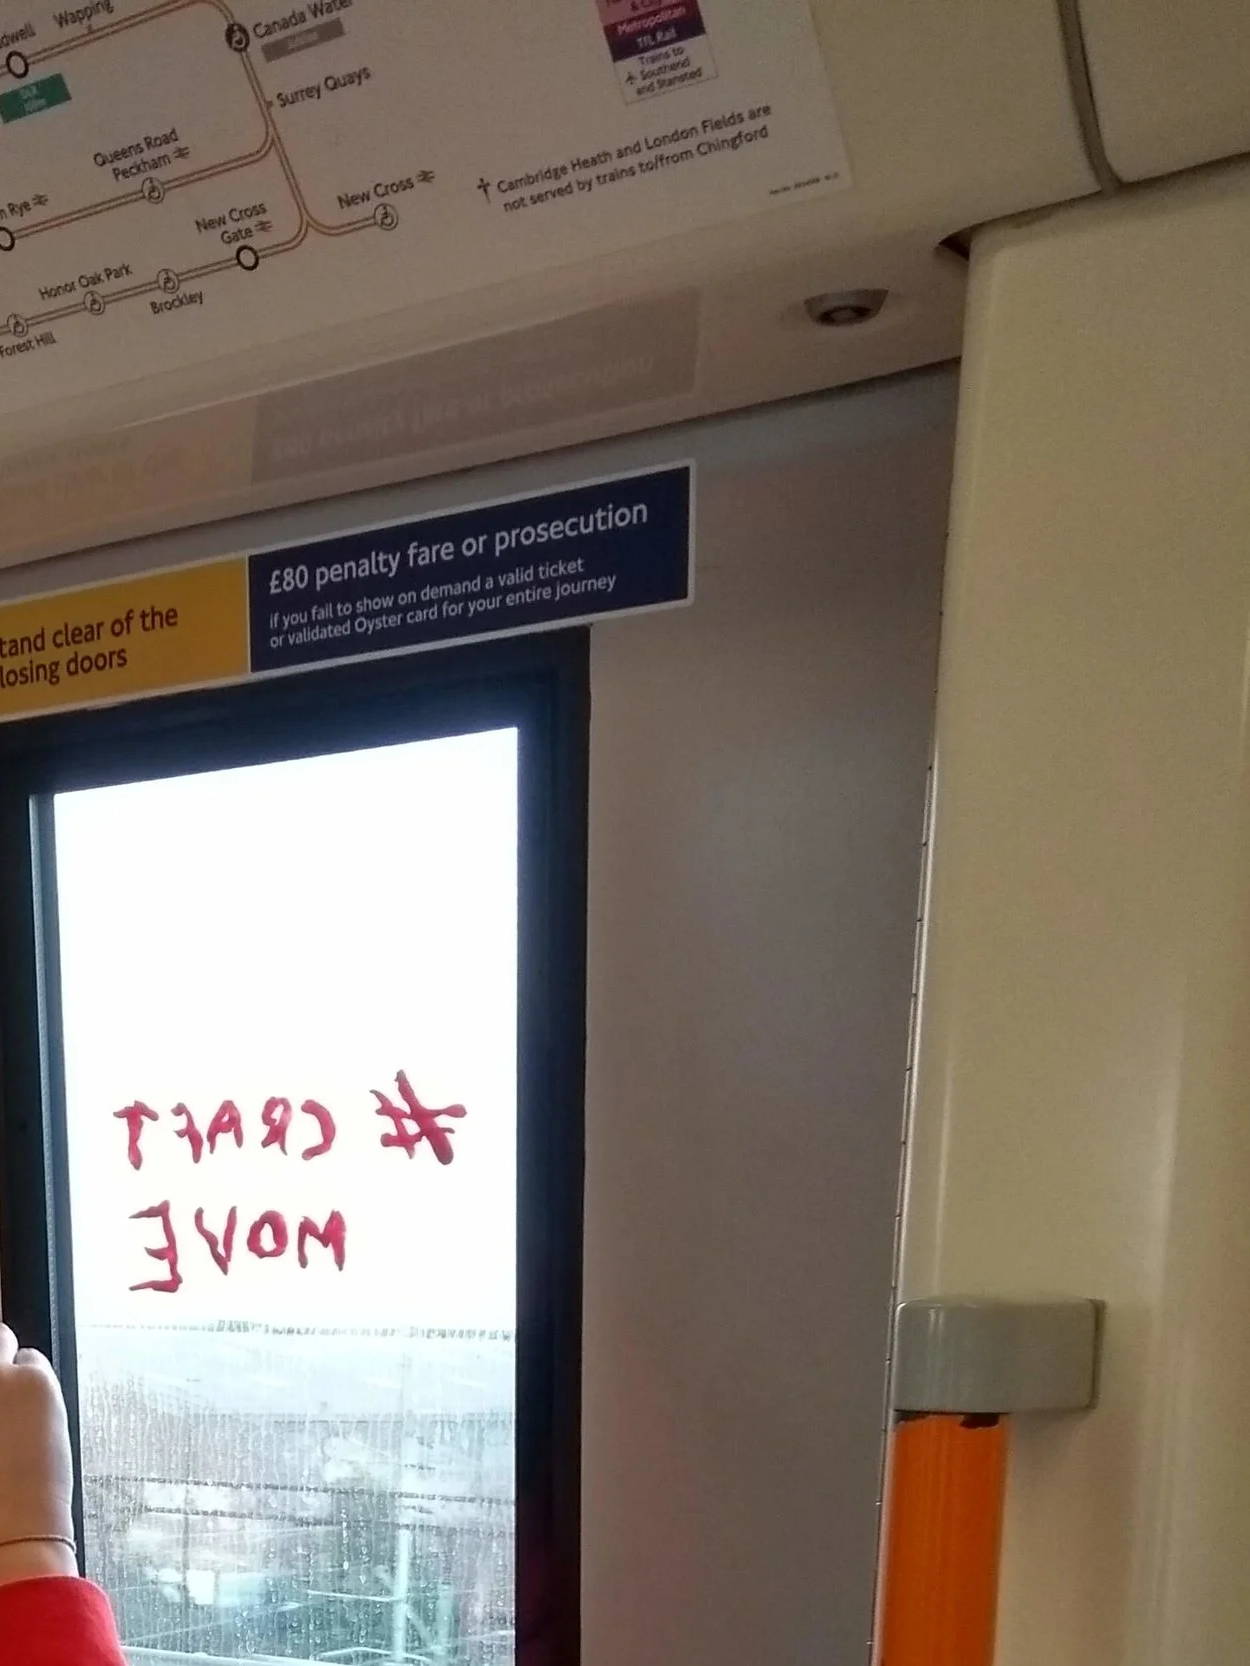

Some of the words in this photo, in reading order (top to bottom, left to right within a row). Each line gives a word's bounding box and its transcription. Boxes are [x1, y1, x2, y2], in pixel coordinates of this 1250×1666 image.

[52, 0, 115, 30] Wapping
[252, 10, 307, 40] Canada
[276, 87, 323, 110] Surrey
[323, 66, 373, 93] Quays
[93, 139, 144, 168] Queens
[142, 126, 180, 152] Road
[496, 163, 569, 194] Cambridge
[570, 151, 613, 173] Heath
[616, 141, 642, 160] and
[644, 124, 699, 151] London
[701, 109, 745, 133] Fields
[747, 103, 772, 120] are
[111, 154, 172, 183] Peckham
[503, 197, 527, 213] not
[530, 184, 574, 206] served
[576, 176, 593, 193] by
[595, 164, 636, 186] trains
[638, 147, 694, 172] to/from
[696, 124, 769, 156] Chingford
[6, 199, 33, 219] Rye
[336, 191, 371, 210] New
[373, 176, 415, 199] Cross
[194, 214, 227, 234] New
[228, 202, 268, 223] Cross
[220, 226, 254, 245] Gate
[38, 280, 77, 301] Honor
[77, 271, 105, 290] Oak
[103, 262, 134, 283] Park
[149, 290, 204, 316] Brockley
[34, 331, 58, 348] Hill
[269, 563, 308, 595] £80
[314, 549, 403, 591] penalty
[407, 538, 455, 570] fare
[461, 534, 489, 558] or
[494, 502, 648, 557] prosecution
[269, 611, 280, 630] If
[281, 609, 308, 630] you
[310, 602, 334, 622] fail
[335, 599, 352, 616] to
[354, 593, 394, 614] show
[397, 589, 418, 606] on
[420, 575, 481, 602] demand
[484, 575, 494, 590] a
[497, 566, 534, 588] valid
[537, 557, 585, 582] ticket
[52, 619, 105, 648] clear
[110, 607, 135, 638] of
[139, 604, 179, 632] the
[269, 633, 285, 649] or
[287, 618, 351, 646] validated
[353, 610, 403, 637] Oyster
[405, 602, 438, 625] card
[440, 598, 465, 618] for
[466, 593, 503, 617] your
[505, 582, 553, 607] entire
[553, 573, 617, 603] journey
[65, 645, 129, 677] doors
